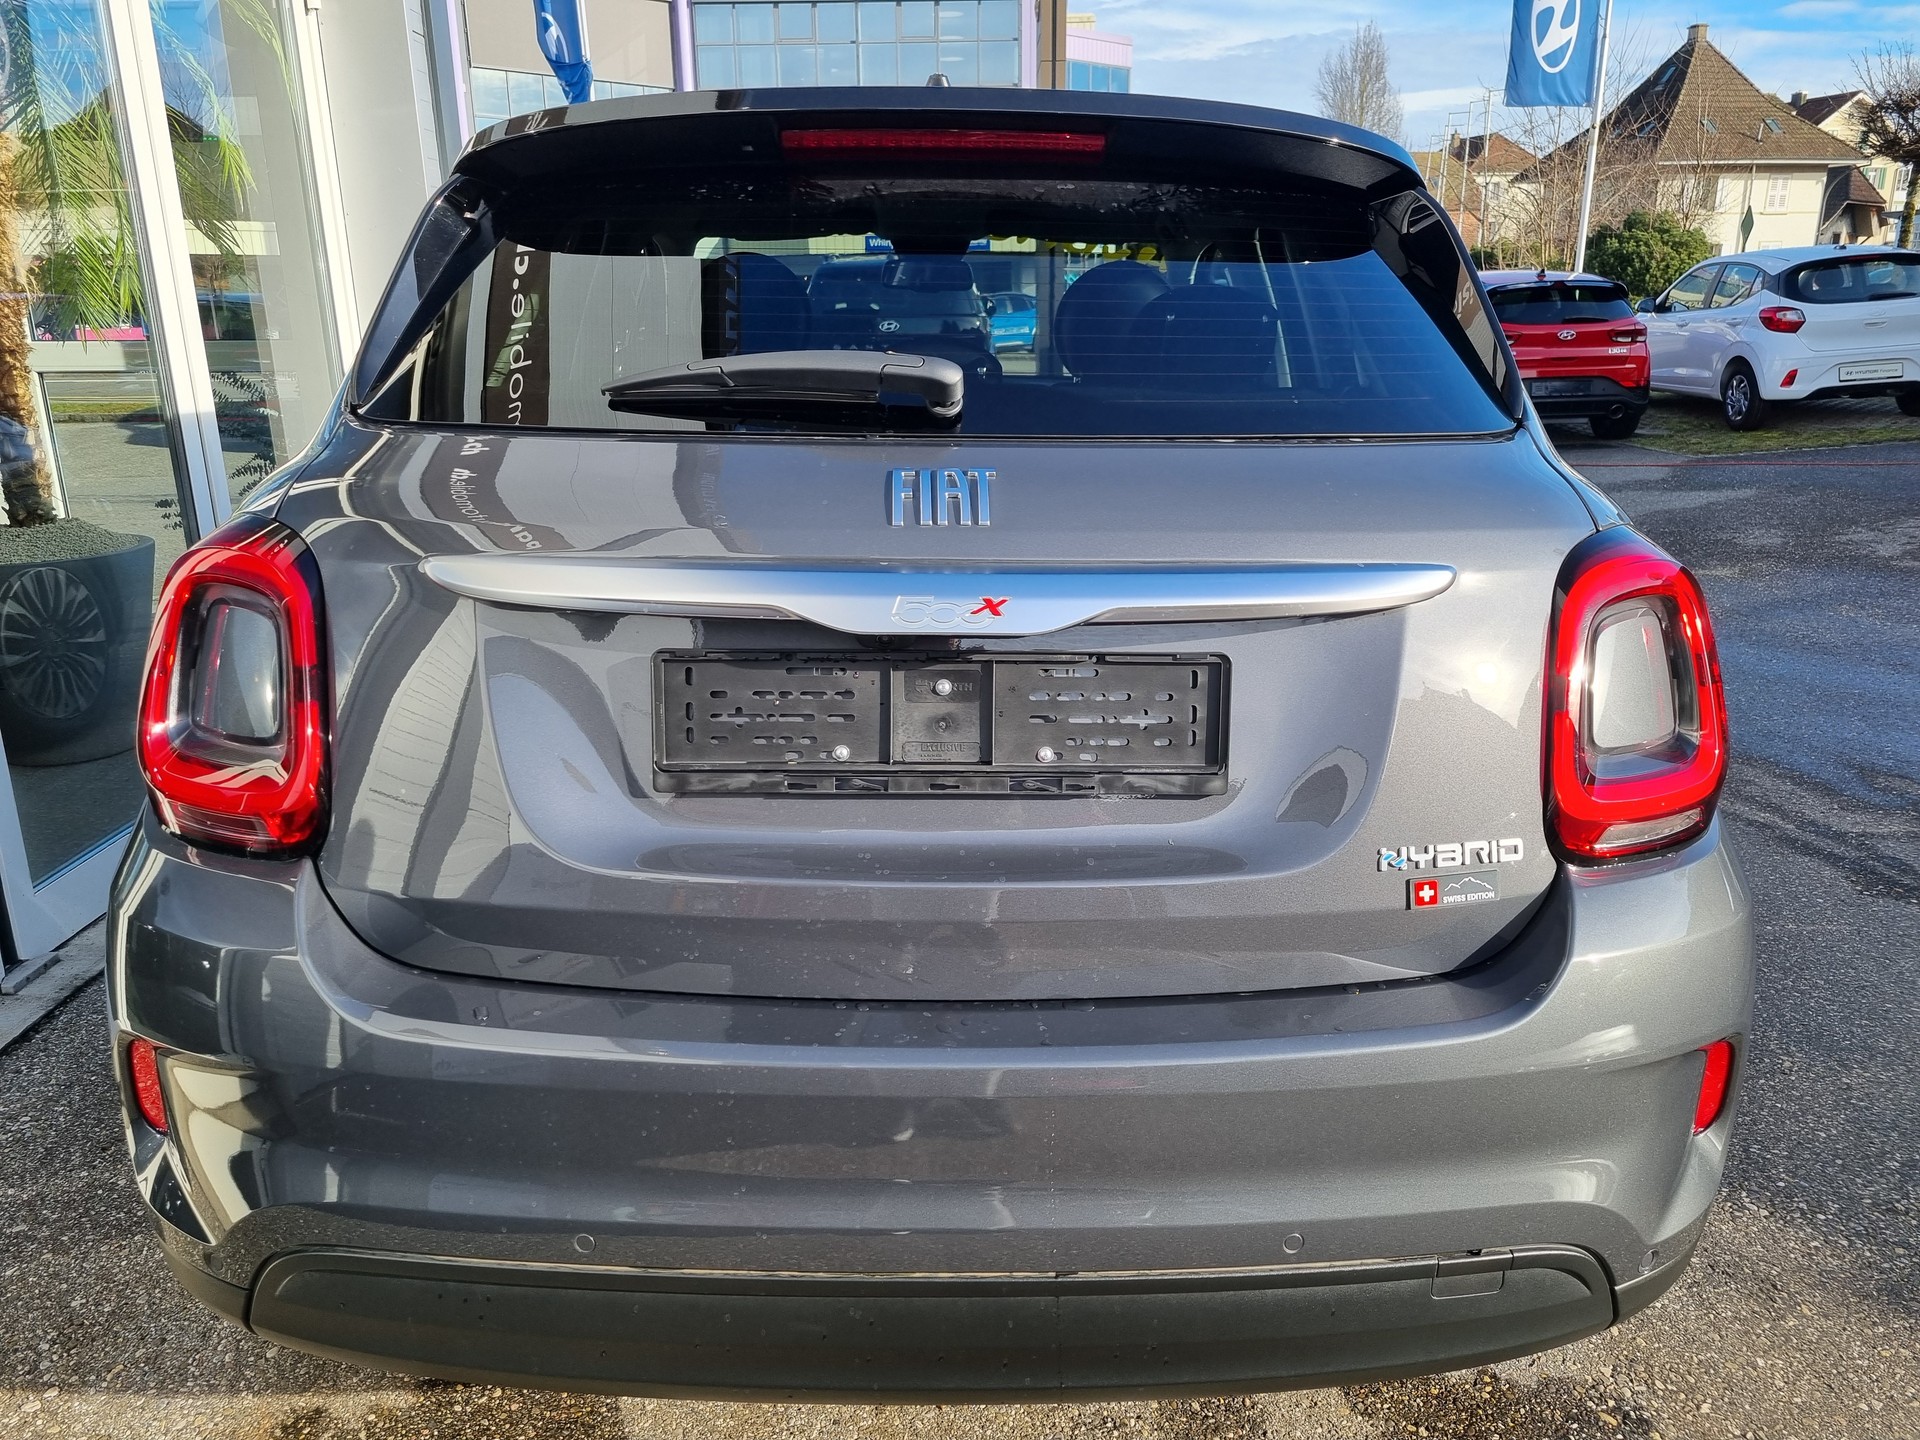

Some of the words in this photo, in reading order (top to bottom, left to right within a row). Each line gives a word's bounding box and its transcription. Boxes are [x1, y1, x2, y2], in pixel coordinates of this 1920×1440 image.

[891, 467, 997, 528] FIAT
[920, 742, 967, 753] EXCLUSIVE
[1377, 838, 1524, 872] HYBRID
[1442, 894, 1466, 904] SWISS
[1467, 891, 1495, 903] EDITION
